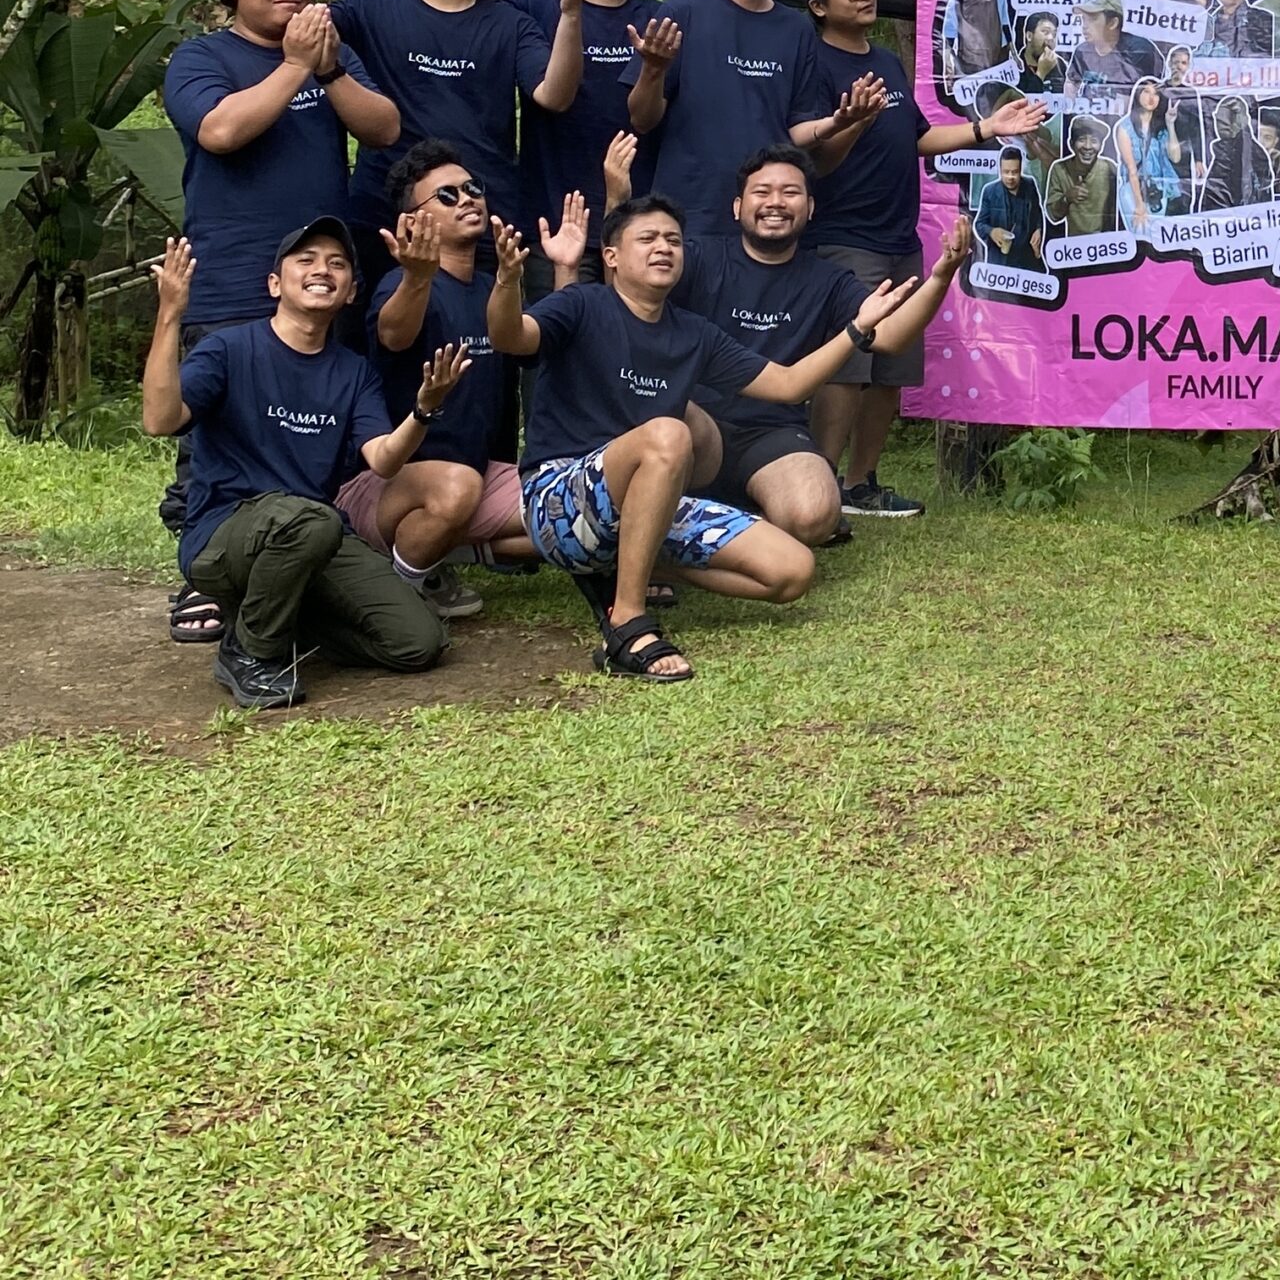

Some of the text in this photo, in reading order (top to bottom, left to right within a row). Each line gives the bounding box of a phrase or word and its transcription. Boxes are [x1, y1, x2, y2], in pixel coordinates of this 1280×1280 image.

[1126, 5, 1197, 33] ribettt
[1226, 67, 1253, 86] Lu
[940, 155, 996, 170] Monmaap
[1161, 219, 1219, 244] Masih
[1225, 216, 1262, 238] gua
[1053, 241, 1128, 262] oke gass
[1213, 241, 1269, 266] Biarin
[976, 267, 1053, 295] Ngopi gess
[1167, 374, 1264, 400] FAMILY
